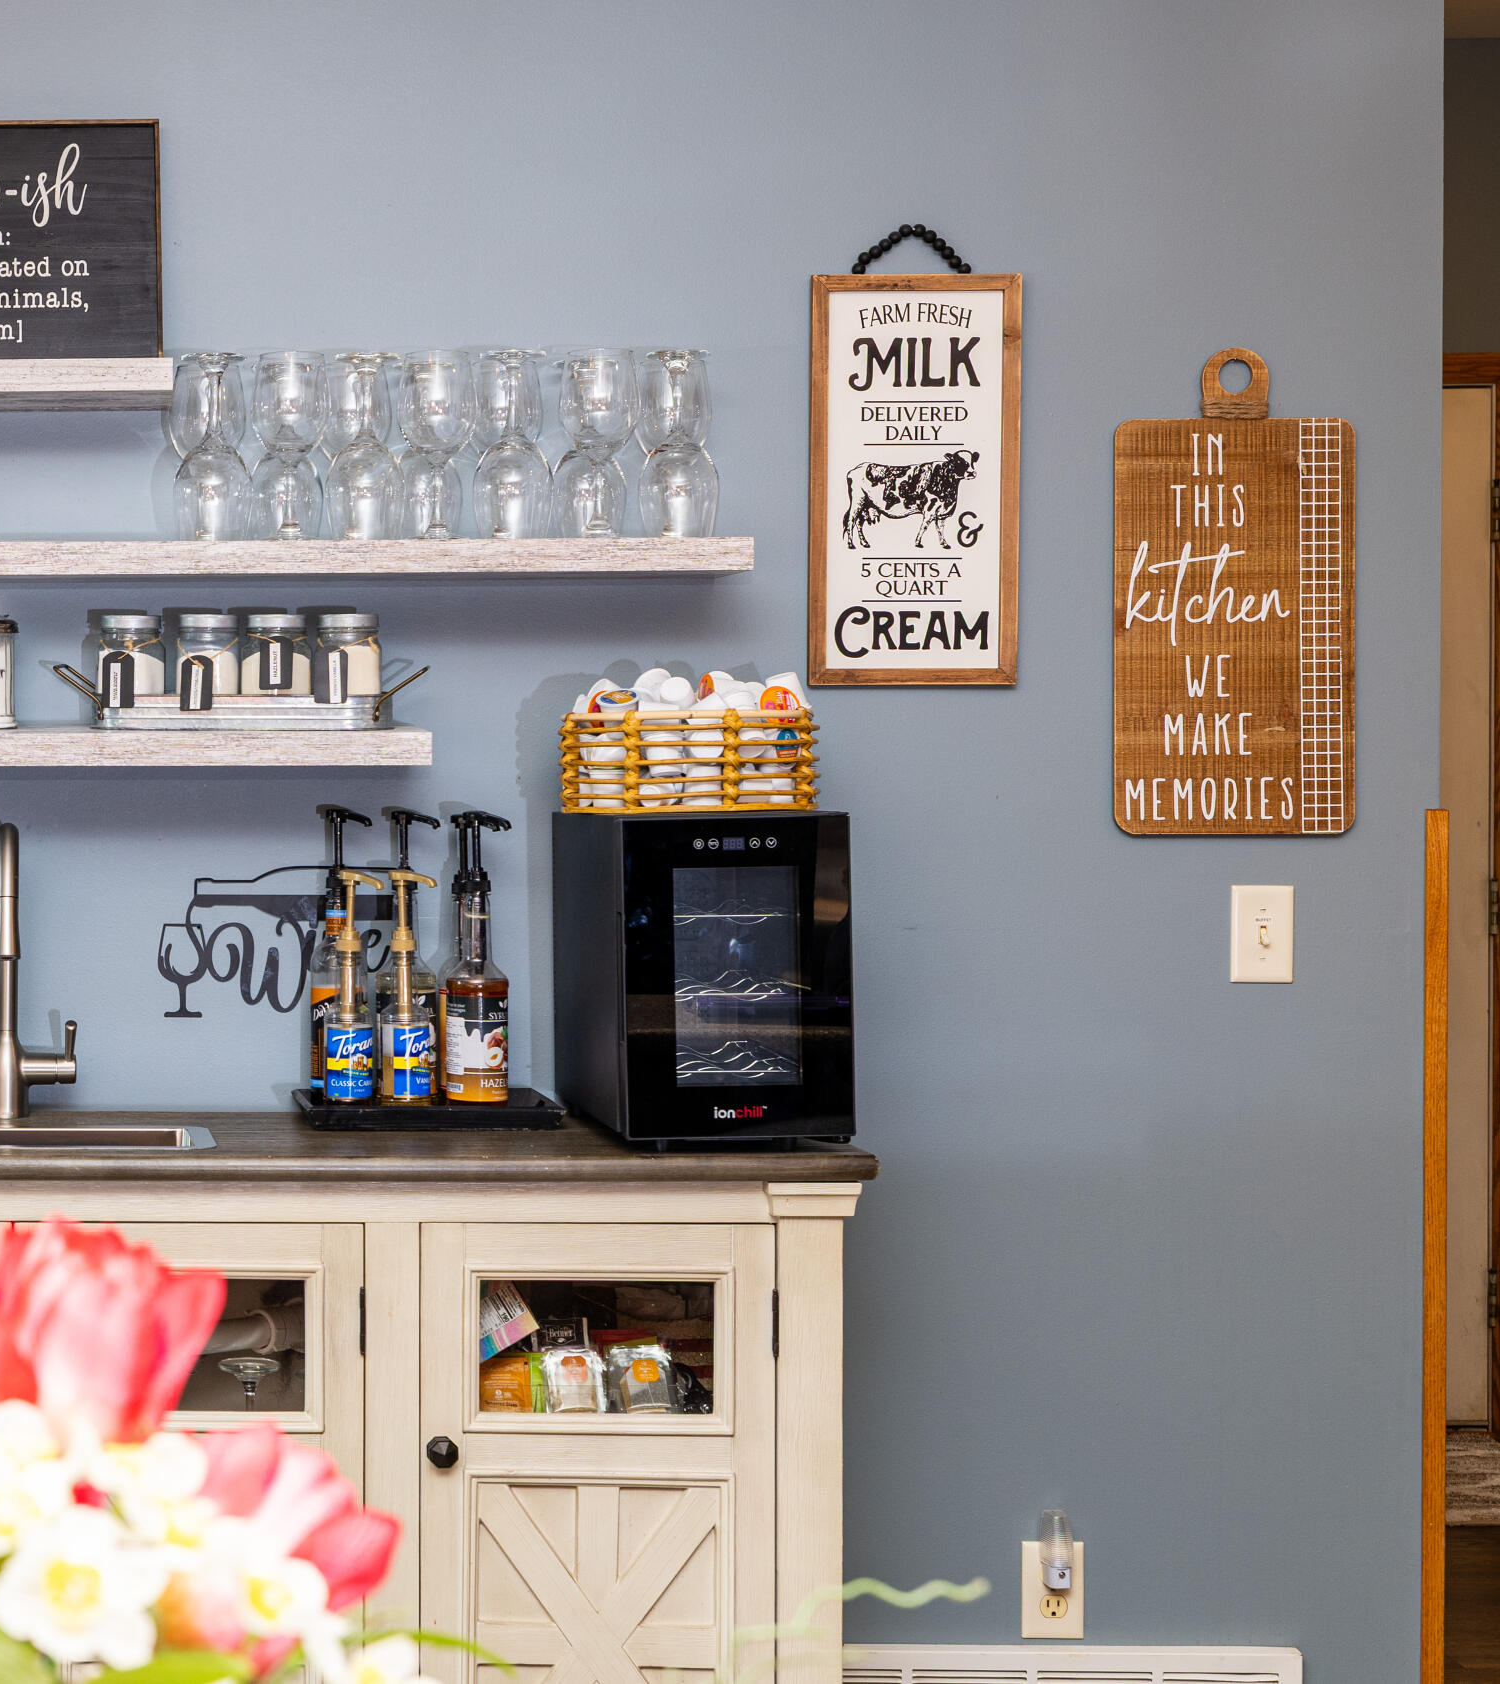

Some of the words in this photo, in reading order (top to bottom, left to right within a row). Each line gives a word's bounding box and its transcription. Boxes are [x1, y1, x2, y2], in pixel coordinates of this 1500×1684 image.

[61, 259, 90, 277] on
[859, 302, 911, 329] FARM
[917, 302, 973, 329] FRESH
[848, 336, 981, 392] MILK
[860, 406, 969, 422] DELIVERED
[885, 425, 942, 441] DAILY
[1191, 433, 1223, 477] IN
[1169, 483, 1245, 528] THIS
[956, 510, 984, 548] &
[861, 562, 871, 578] 5
[877, 562, 940, 578] CENTS
[947, 562, 962, 578] A
[875, 580, 949, 598] QUART
[1125, 540, 1291, 647] kitchen
[834, 605, 990, 659] CREAM
[1185, 654, 1231, 698] WE
[1162, 712, 1253, 756] MAKE
[1125, 776, 1294, 821] MEMORIES
